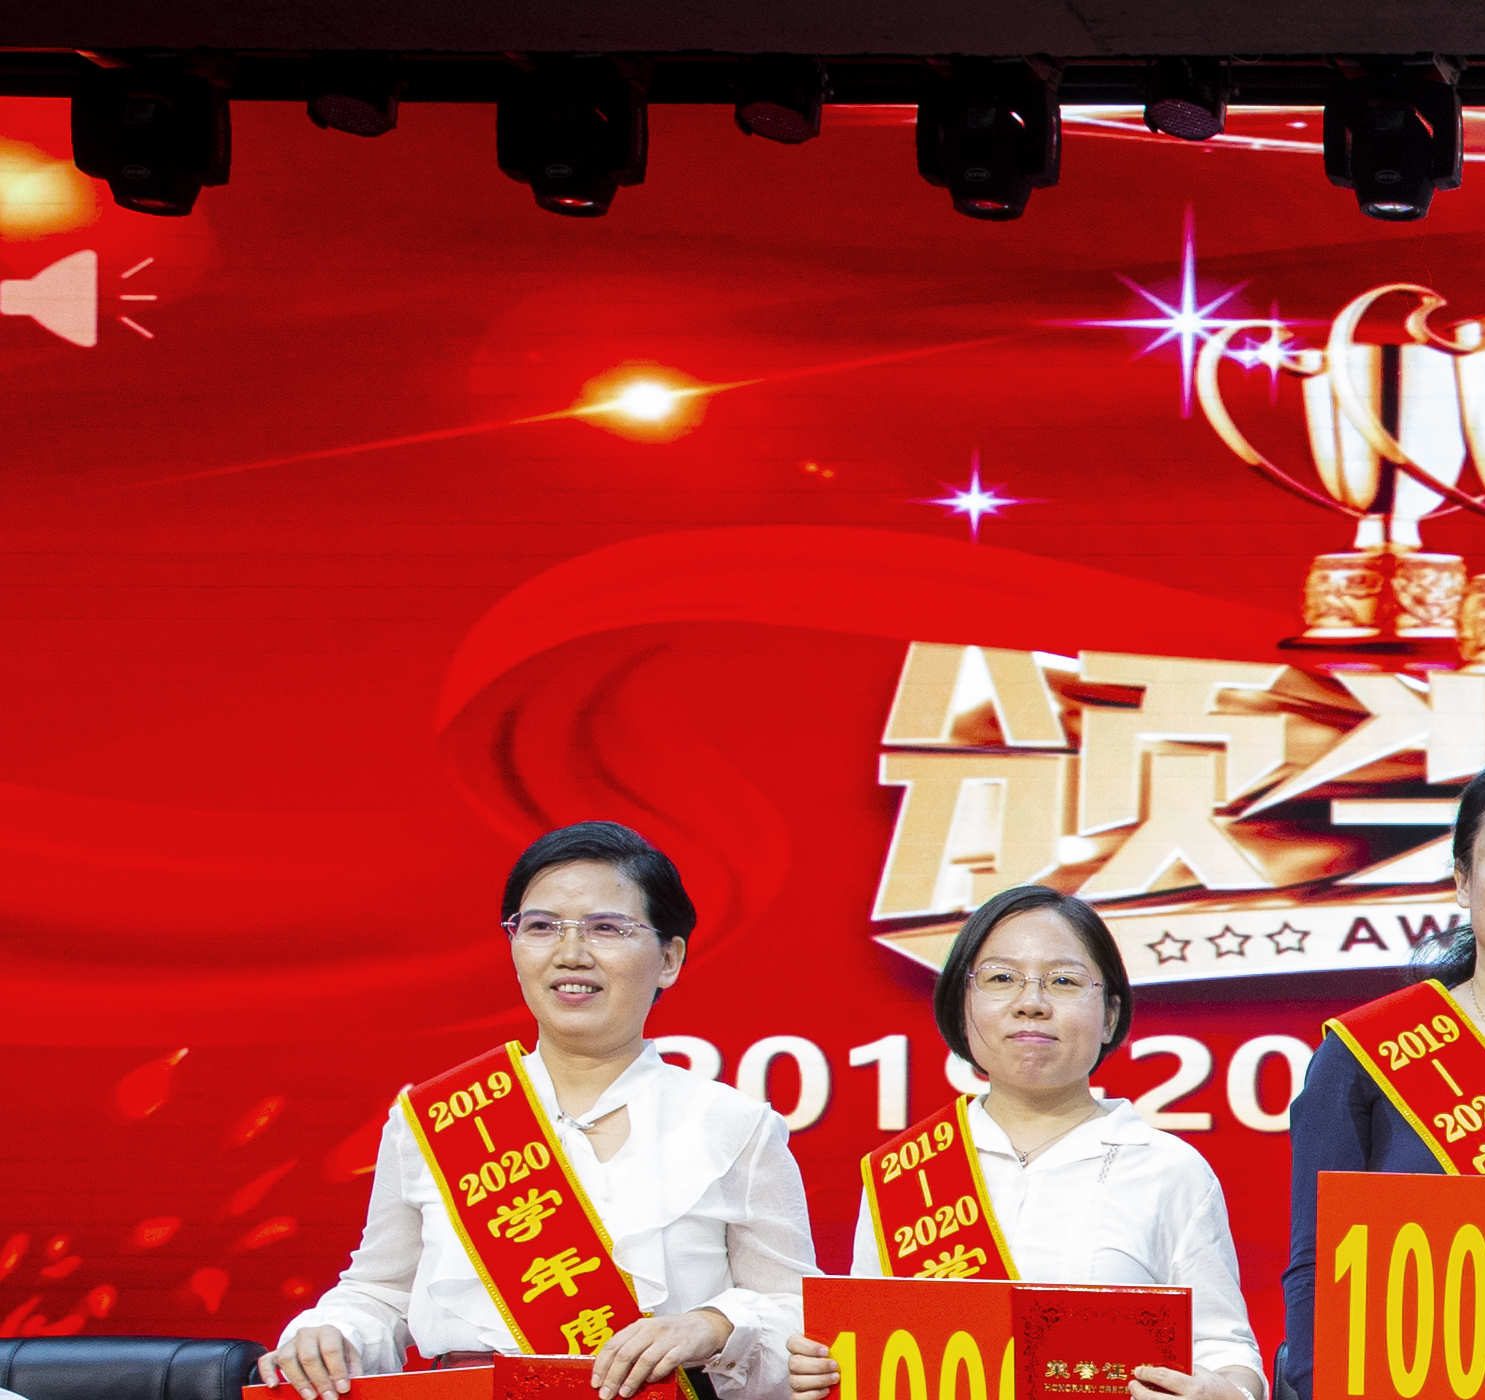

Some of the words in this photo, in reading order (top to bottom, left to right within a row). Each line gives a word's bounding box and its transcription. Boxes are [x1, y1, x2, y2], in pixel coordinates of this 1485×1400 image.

[1378, 1014, 1461, 1071] 2019
[428, 1071, 512, 1133] 2019
[459, 1141, 550, 1207] 2020
[881, 1121, 954, 1184] 2019
[894, 1195, 979, 1258] 2020
[487, 1188, 615, 1355] 学年度
[1044, 1383, 1096, 1394] HONORARY
[1045, 1360, 1153, 1380] 荣誉证
